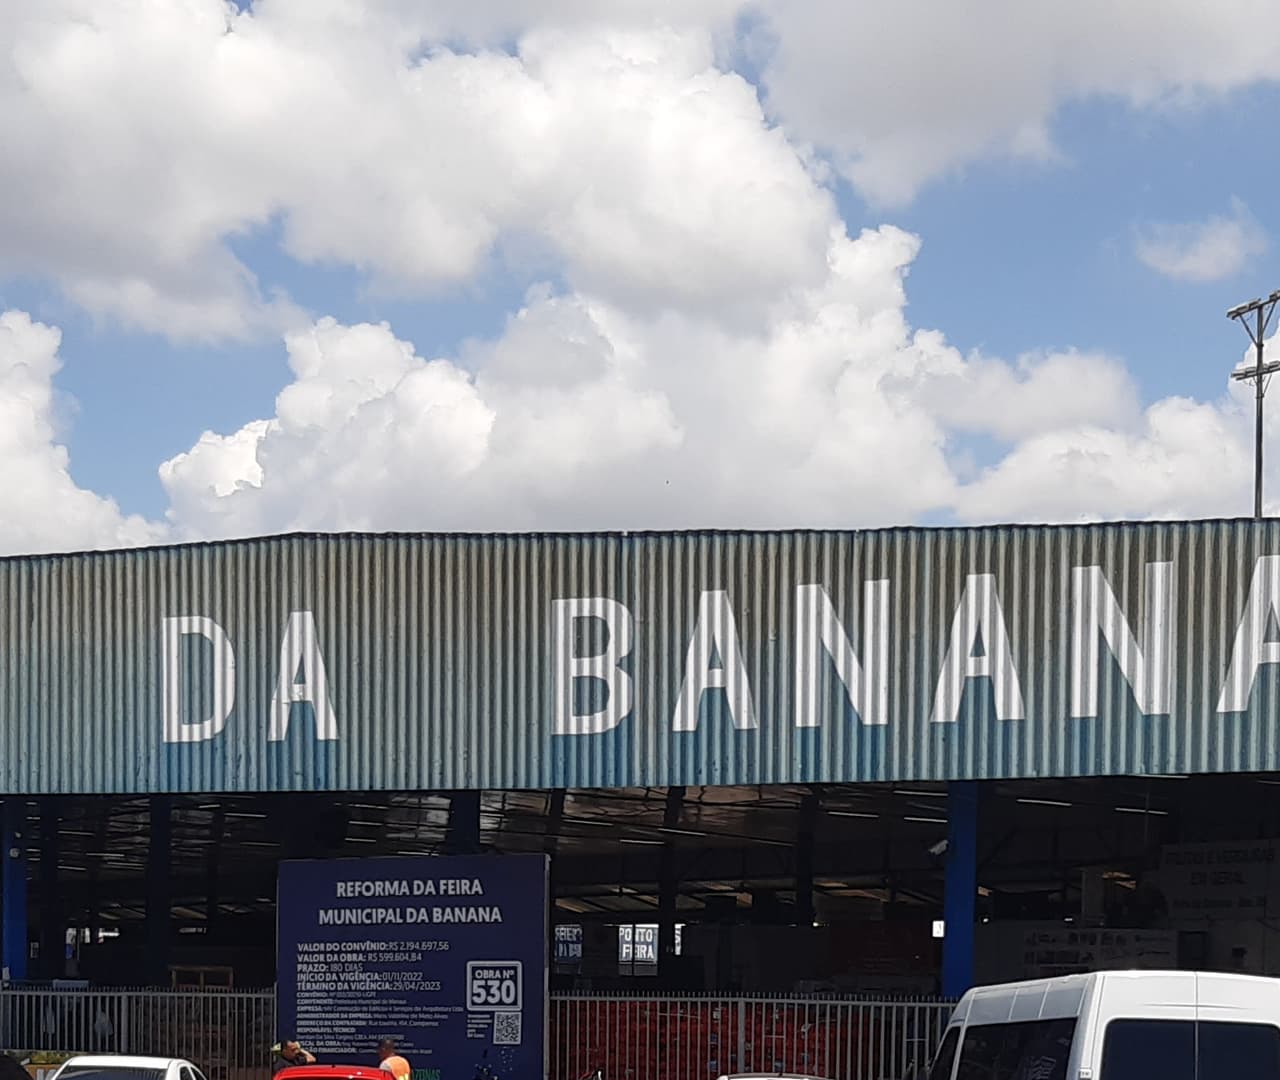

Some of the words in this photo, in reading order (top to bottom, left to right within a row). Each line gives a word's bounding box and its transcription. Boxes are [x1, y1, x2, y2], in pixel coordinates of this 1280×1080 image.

[162, 610, 339, 743] DA
[336, 880, 410, 898] REFORMA
[413, 880, 436, 897] DA
[439, 879, 484, 896] FEIRA
[319, 907, 403, 926] MUNICIPAL
[406, 907, 429, 925] DA
[432, 906, 503, 924] BANANA
[297, 942, 325, 952] VALOR
[326, 942, 340, 951] DO
[297, 953, 325, 962] VALOR
[326, 953, 339, 962] DA
[340, 953, 367, 962] OBRA:
[297, 963, 329, 972] PRAZO:
[345, 963, 363, 972] DIAS
[326, 972, 338, 981] DA
[475, 969, 501, 979] OBRA
[337, 982, 349, 990] DA
[472, 979, 516, 1004] 530
